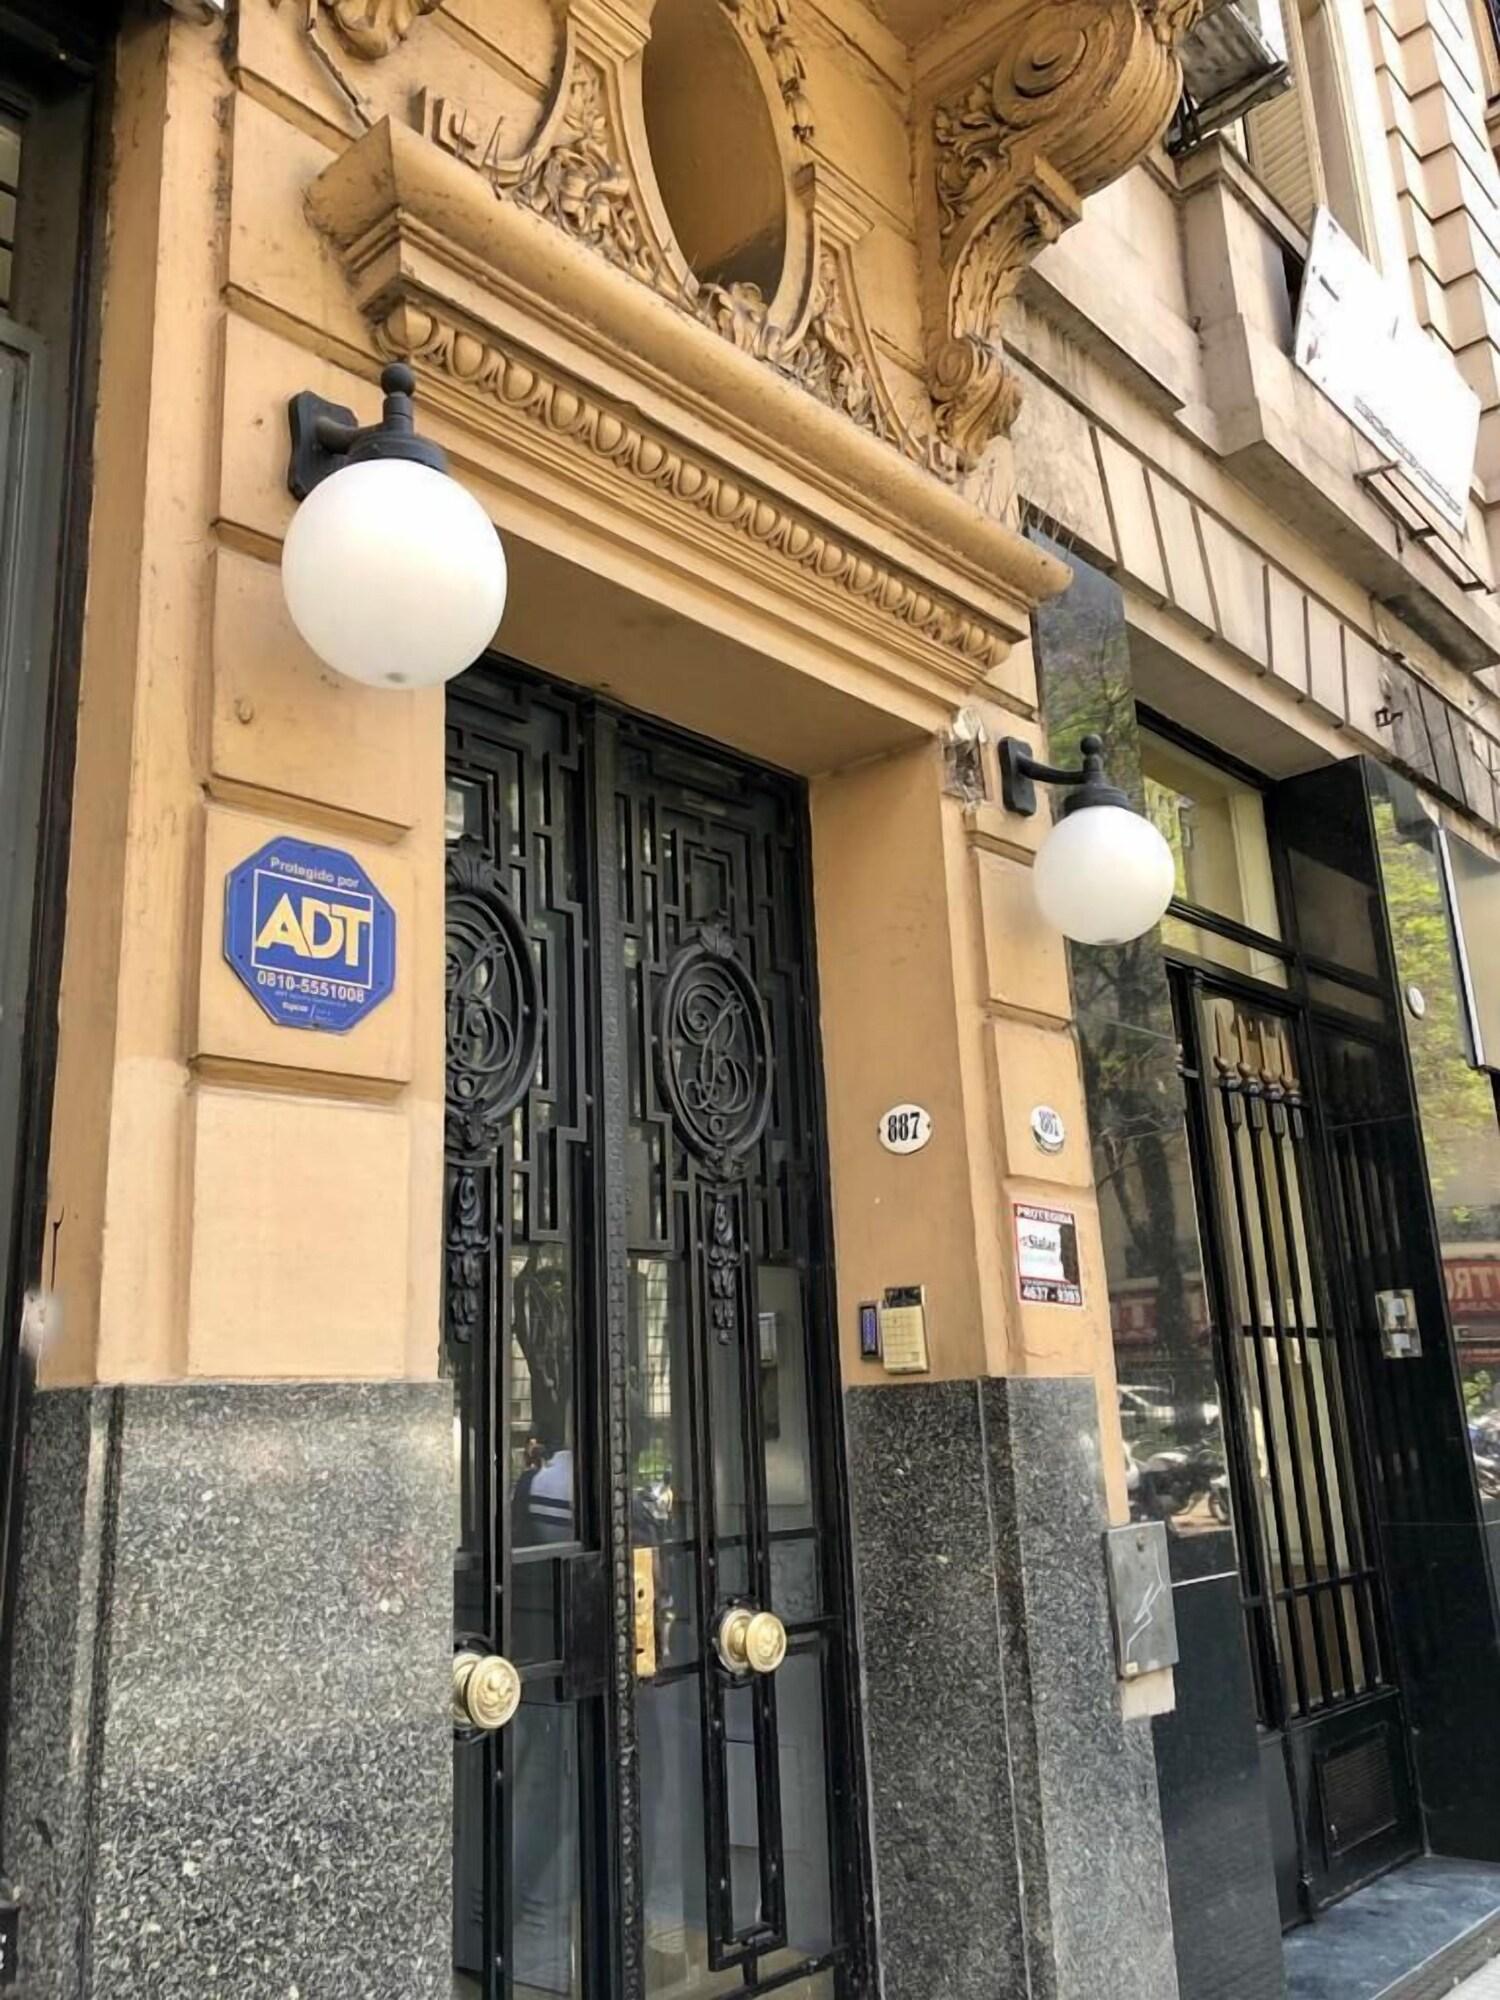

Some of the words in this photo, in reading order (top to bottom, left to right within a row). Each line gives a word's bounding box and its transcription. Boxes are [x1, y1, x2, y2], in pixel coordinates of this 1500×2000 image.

[270, 857, 335, 882] Protegido
[337, 875, 360, 889] por
[255, 892, 371, 967] ADT
[257, 970, 365, 1003] 0810-5551008
[888, 1111, 920, 1143] 887
